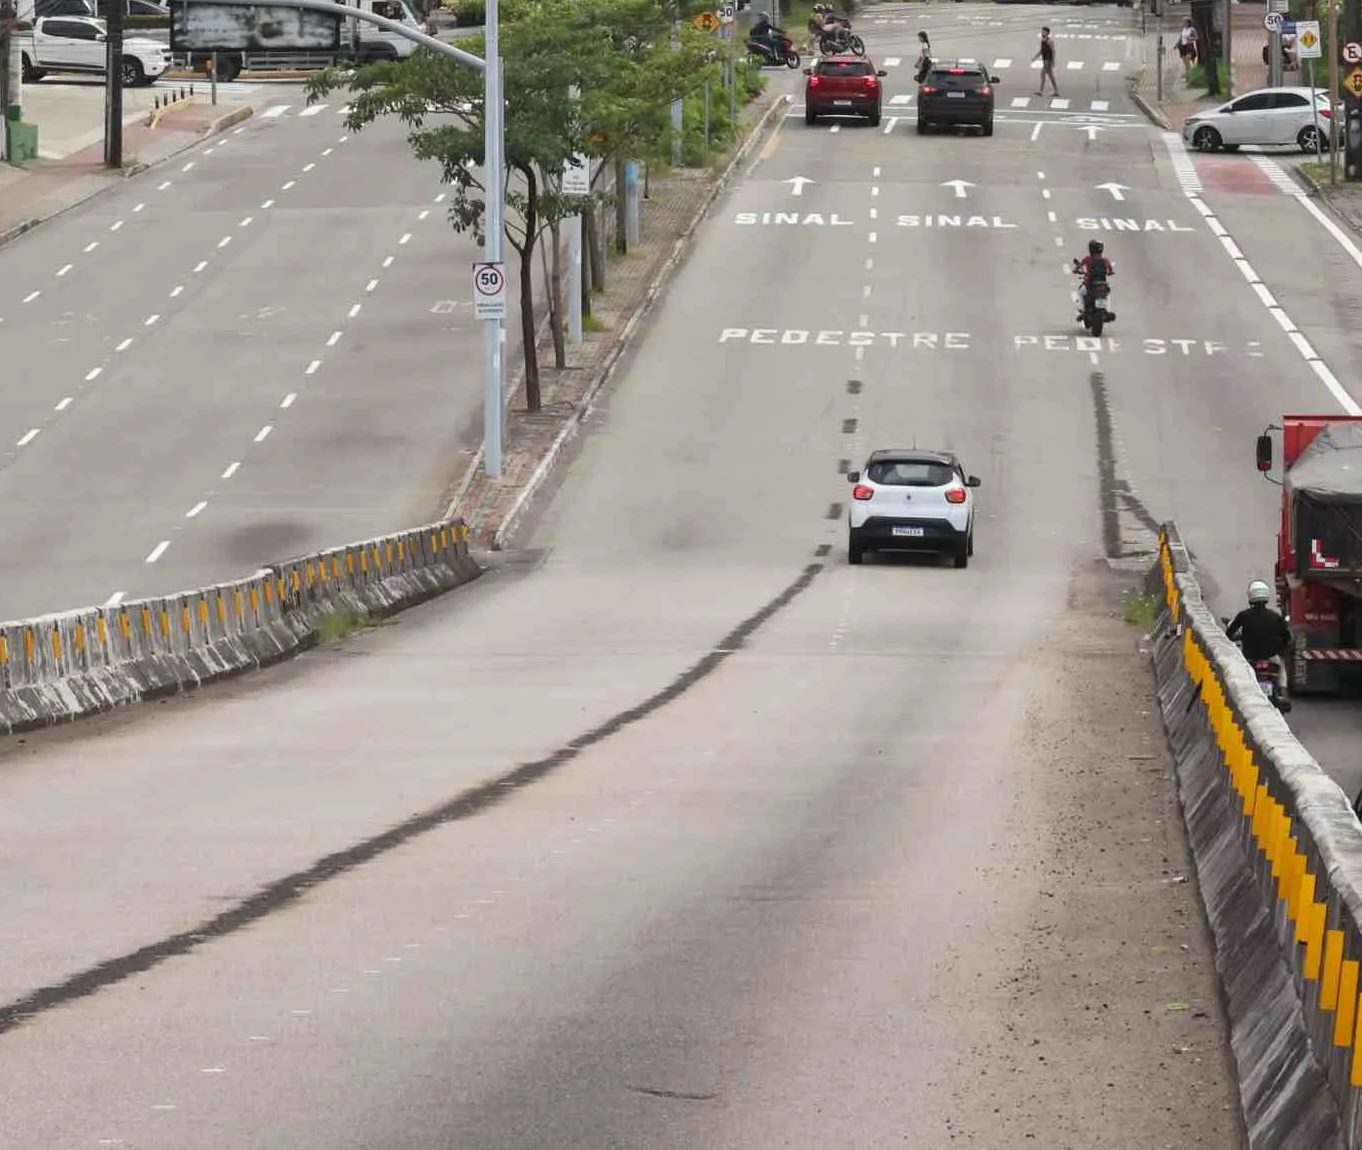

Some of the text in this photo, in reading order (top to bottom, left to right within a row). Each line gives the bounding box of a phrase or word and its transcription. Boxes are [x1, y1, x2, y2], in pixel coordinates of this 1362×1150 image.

[734, 212, 855, 226] SINAL
[896, 214, 1020, 229] SINAL
[1075, 217, 1197, 232] SINAL
[481, 272, 498, 286] 50
[718, 327, 971, 349] PEDESTRE
